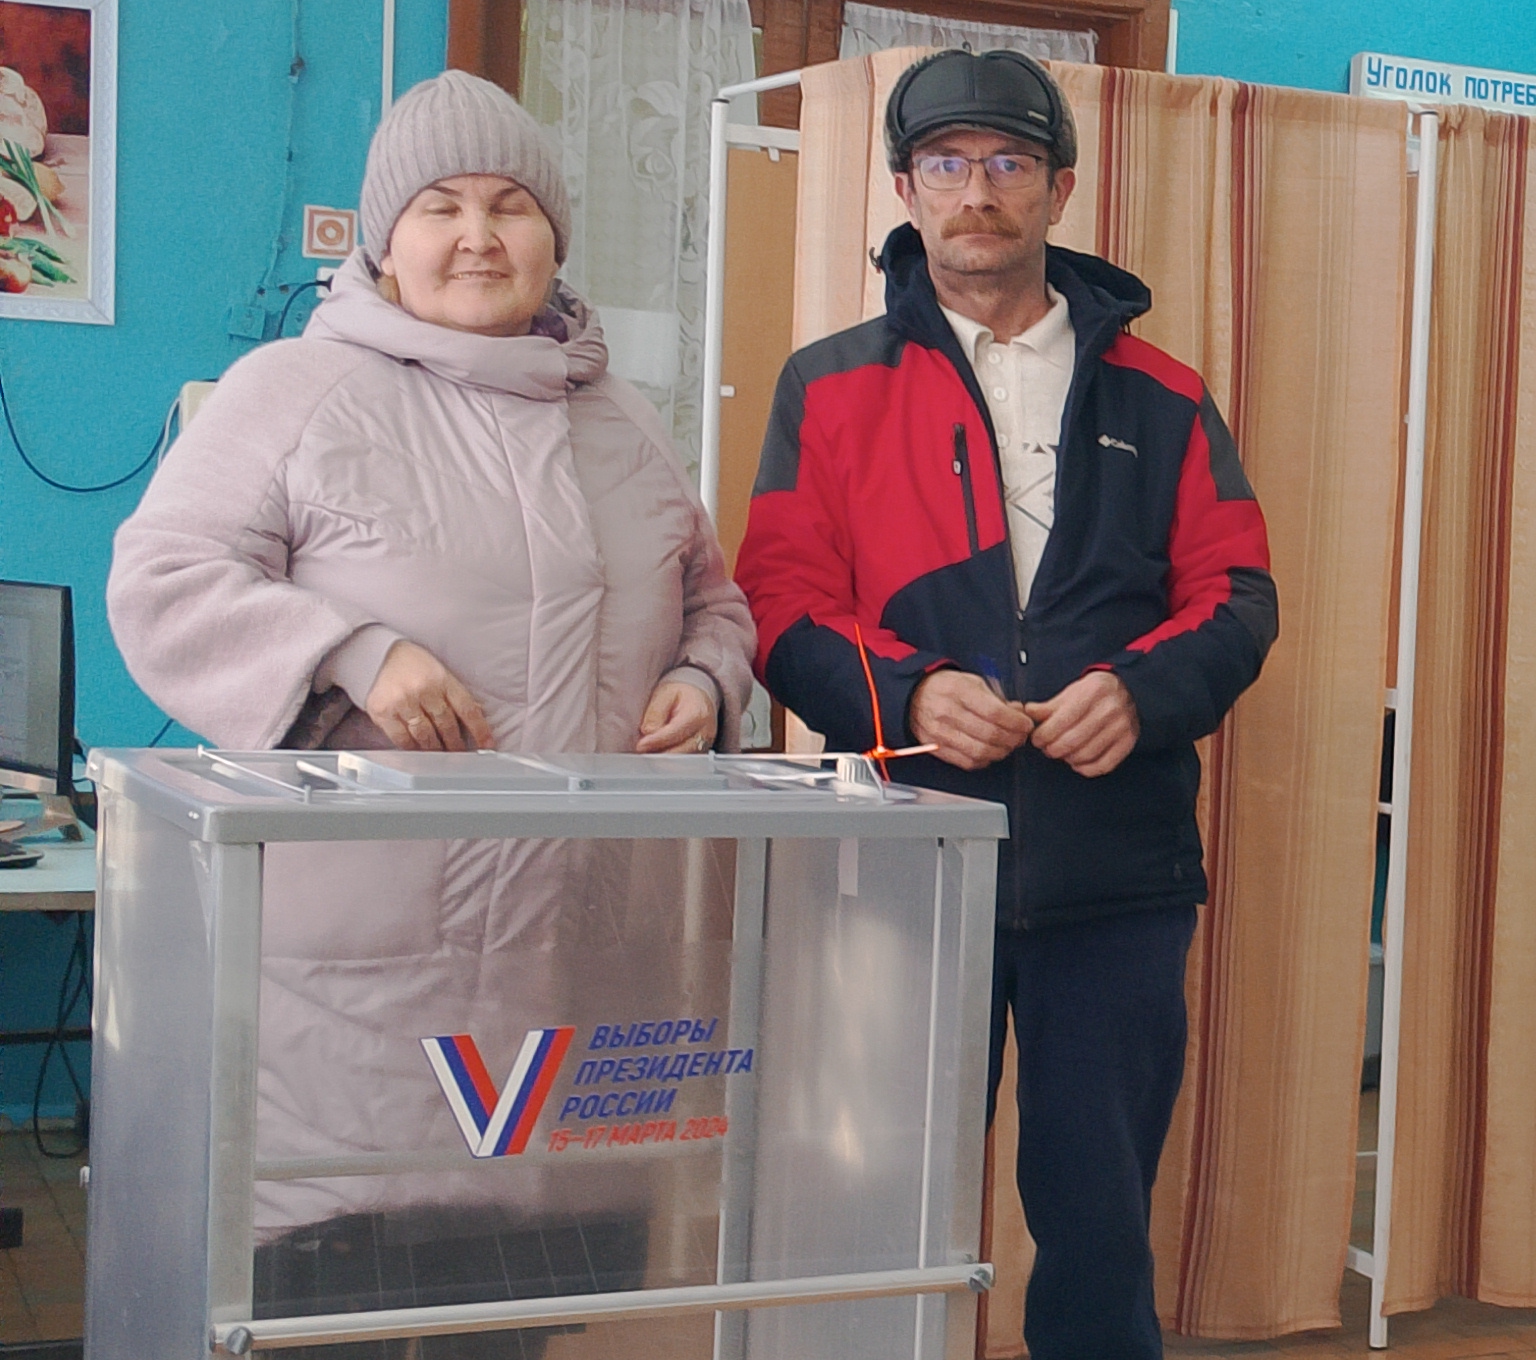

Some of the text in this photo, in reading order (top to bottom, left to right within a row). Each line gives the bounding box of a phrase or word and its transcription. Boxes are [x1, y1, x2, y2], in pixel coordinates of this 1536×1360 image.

[588, 1016, 719, 1051] ВЫБОРЫ
[573, 1048, 754, 1086] ПРЕЗИДЕНТА
[558, 1088, 679, 1122] РОССИИ
[606, 1120, 677, 1148] МАРТА
[679, 1115, 729, 1141] 2024
